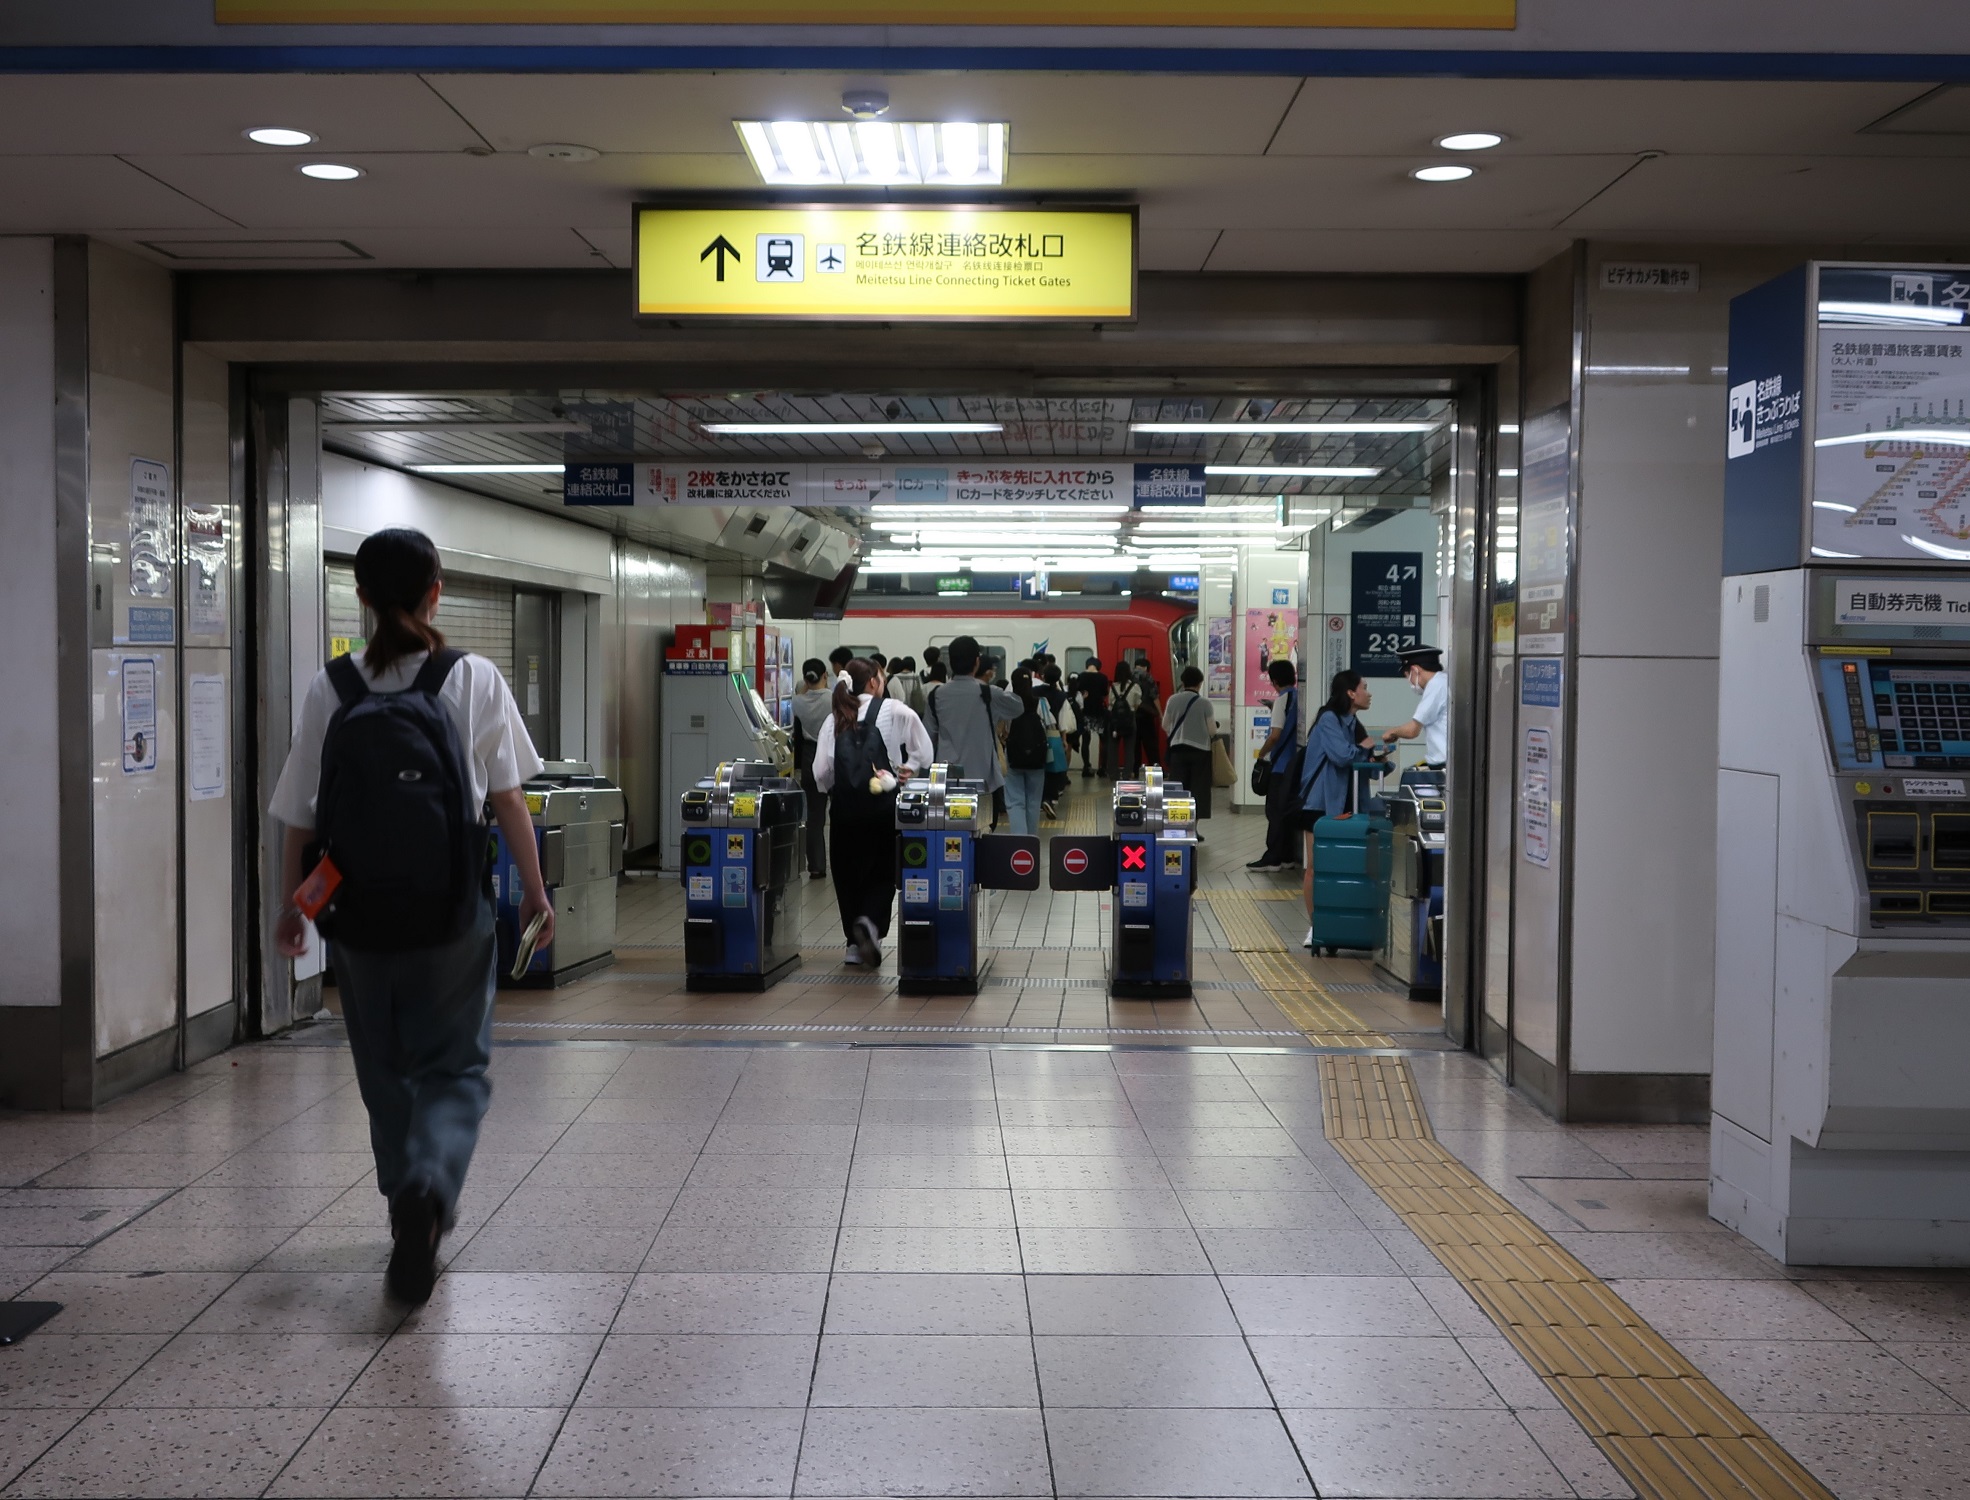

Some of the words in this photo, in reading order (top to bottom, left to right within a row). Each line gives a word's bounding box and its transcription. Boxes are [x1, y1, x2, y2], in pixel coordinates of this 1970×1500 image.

[856, 231, 1064, 258] 名鉄線連絡改札口
[963, 260, 1044, 272] 名铁线连接检票口
[856, 274, 906, 286] Meitetsu
[909, 274, 933, 286] Line
[935, 275, 999, 288] Connecting
[1002, 275, 1036, 286] Ticket
[1038, 276, 1071, 287] Gates
[1608, 267, 1691, 286] ビデオカメラ動作中
[1832, 342, 1963, 358] 名鉄線普通旅客運賃表
[1757, 374, 1783, 401] 名鉄線
[1756, 390, 1801, 425] きっぷうりば
[579, 467, 619, 482] 名鉄線
[687, 470, 790, 487] 2枚をかさねて
[956, 469, 1115, 485] きっぷを先に入れてから
[1149, 468, 1191, 482] 名鉄線
[567, 482, 631, 497] 連絡改札口
[833, 478, 868, 491] きっぷ
[899, 477, 946, 491] ICカード
[1136, 483, 1203, 498] 連絡改札口
[687, 488, 791, 499] 改札機に投入してください
[956, 488, 1114, 501] ICカードをタッチしてください
[1386, 564, 1400, 583] 4
[1850, 592, 1943, 612] 自動券売機
[1946, 600, 1970, 614] Tic
[1169, 813, 1189, 822] 不可
